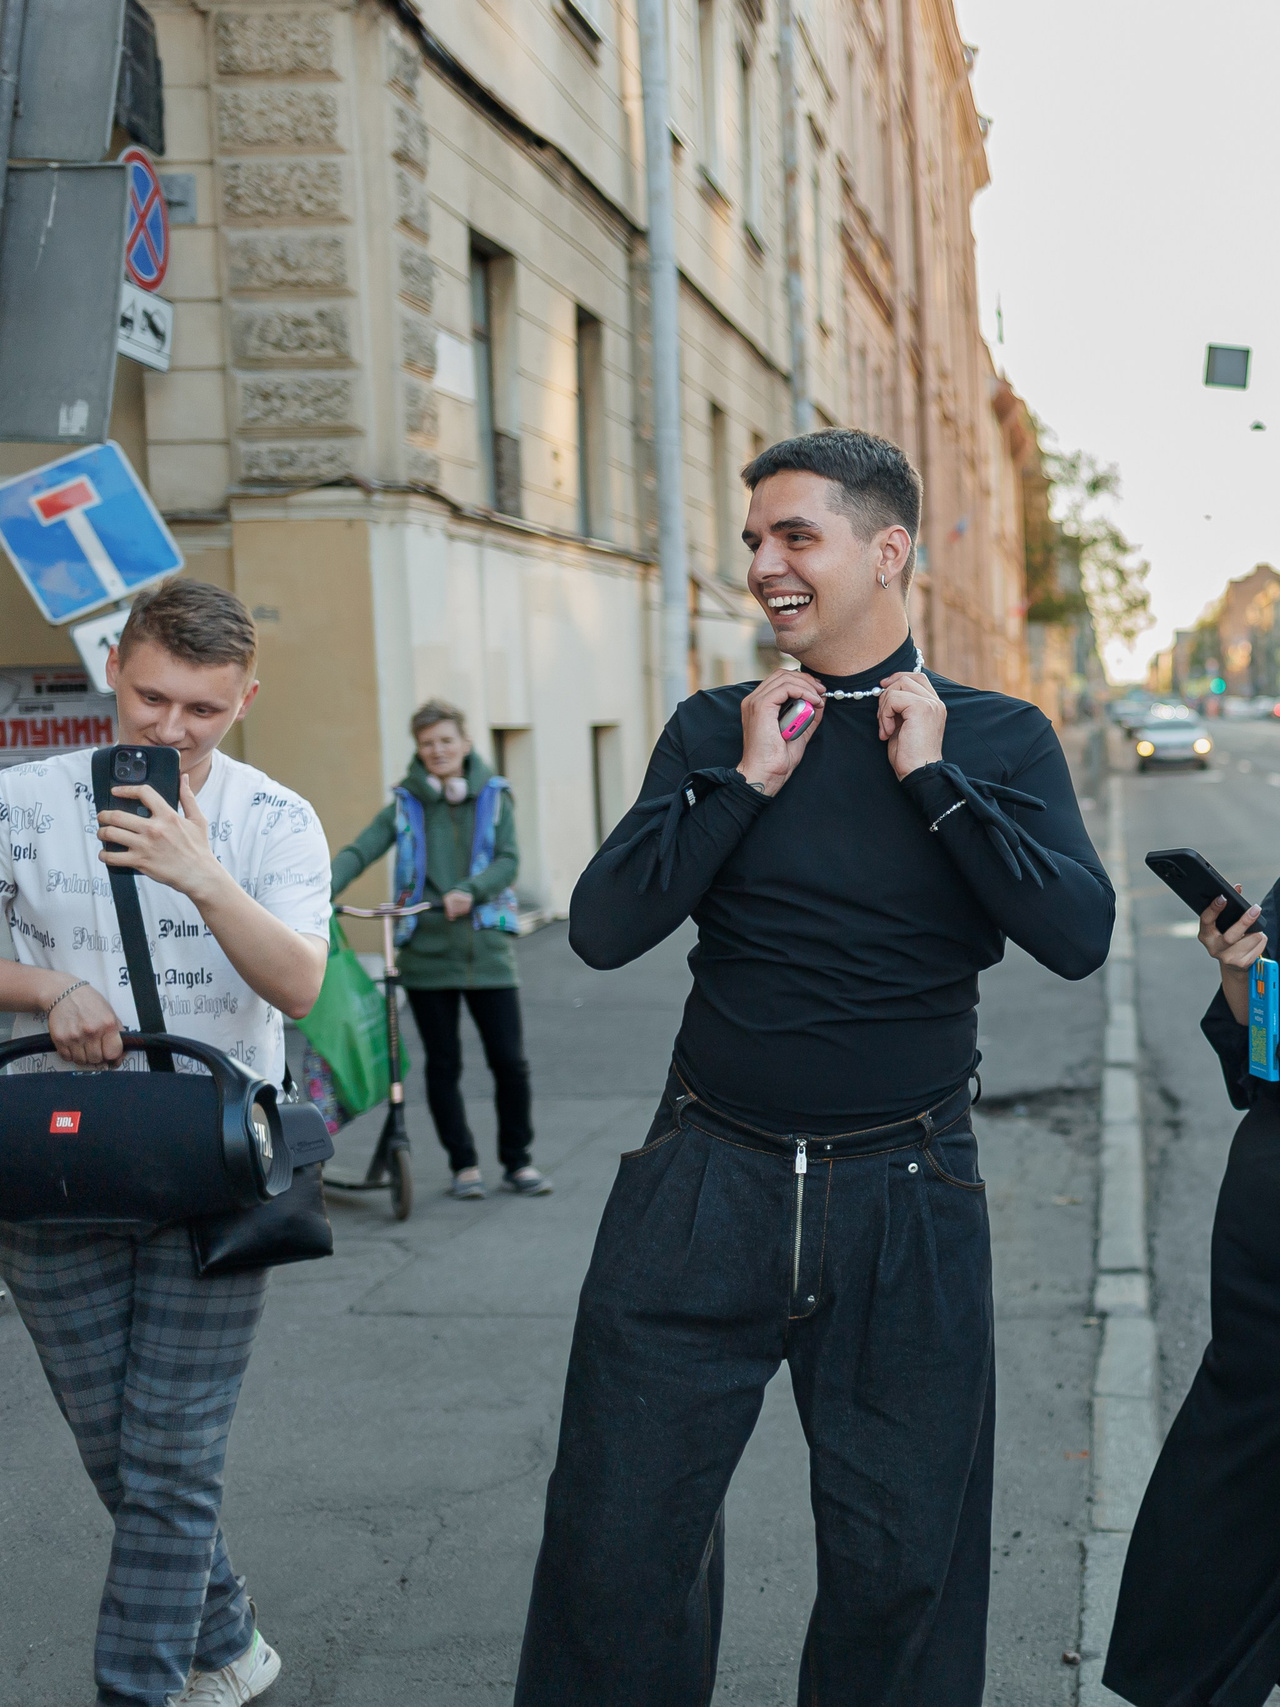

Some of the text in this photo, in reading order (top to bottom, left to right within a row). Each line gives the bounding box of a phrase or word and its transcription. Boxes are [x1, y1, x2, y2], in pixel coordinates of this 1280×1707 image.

[10, 801, 54, 835] gels
[10, 842, 38, 862] gels
[46, 868, 90, 894] Palm
[72, 926, 109, 951] Palm
[158, 918, 200, 939] Palm
[164, 966, 213, 989] Angels
[193, 991, 239, 1020] Angels
[56, 1117, 74, 1128] JBL
